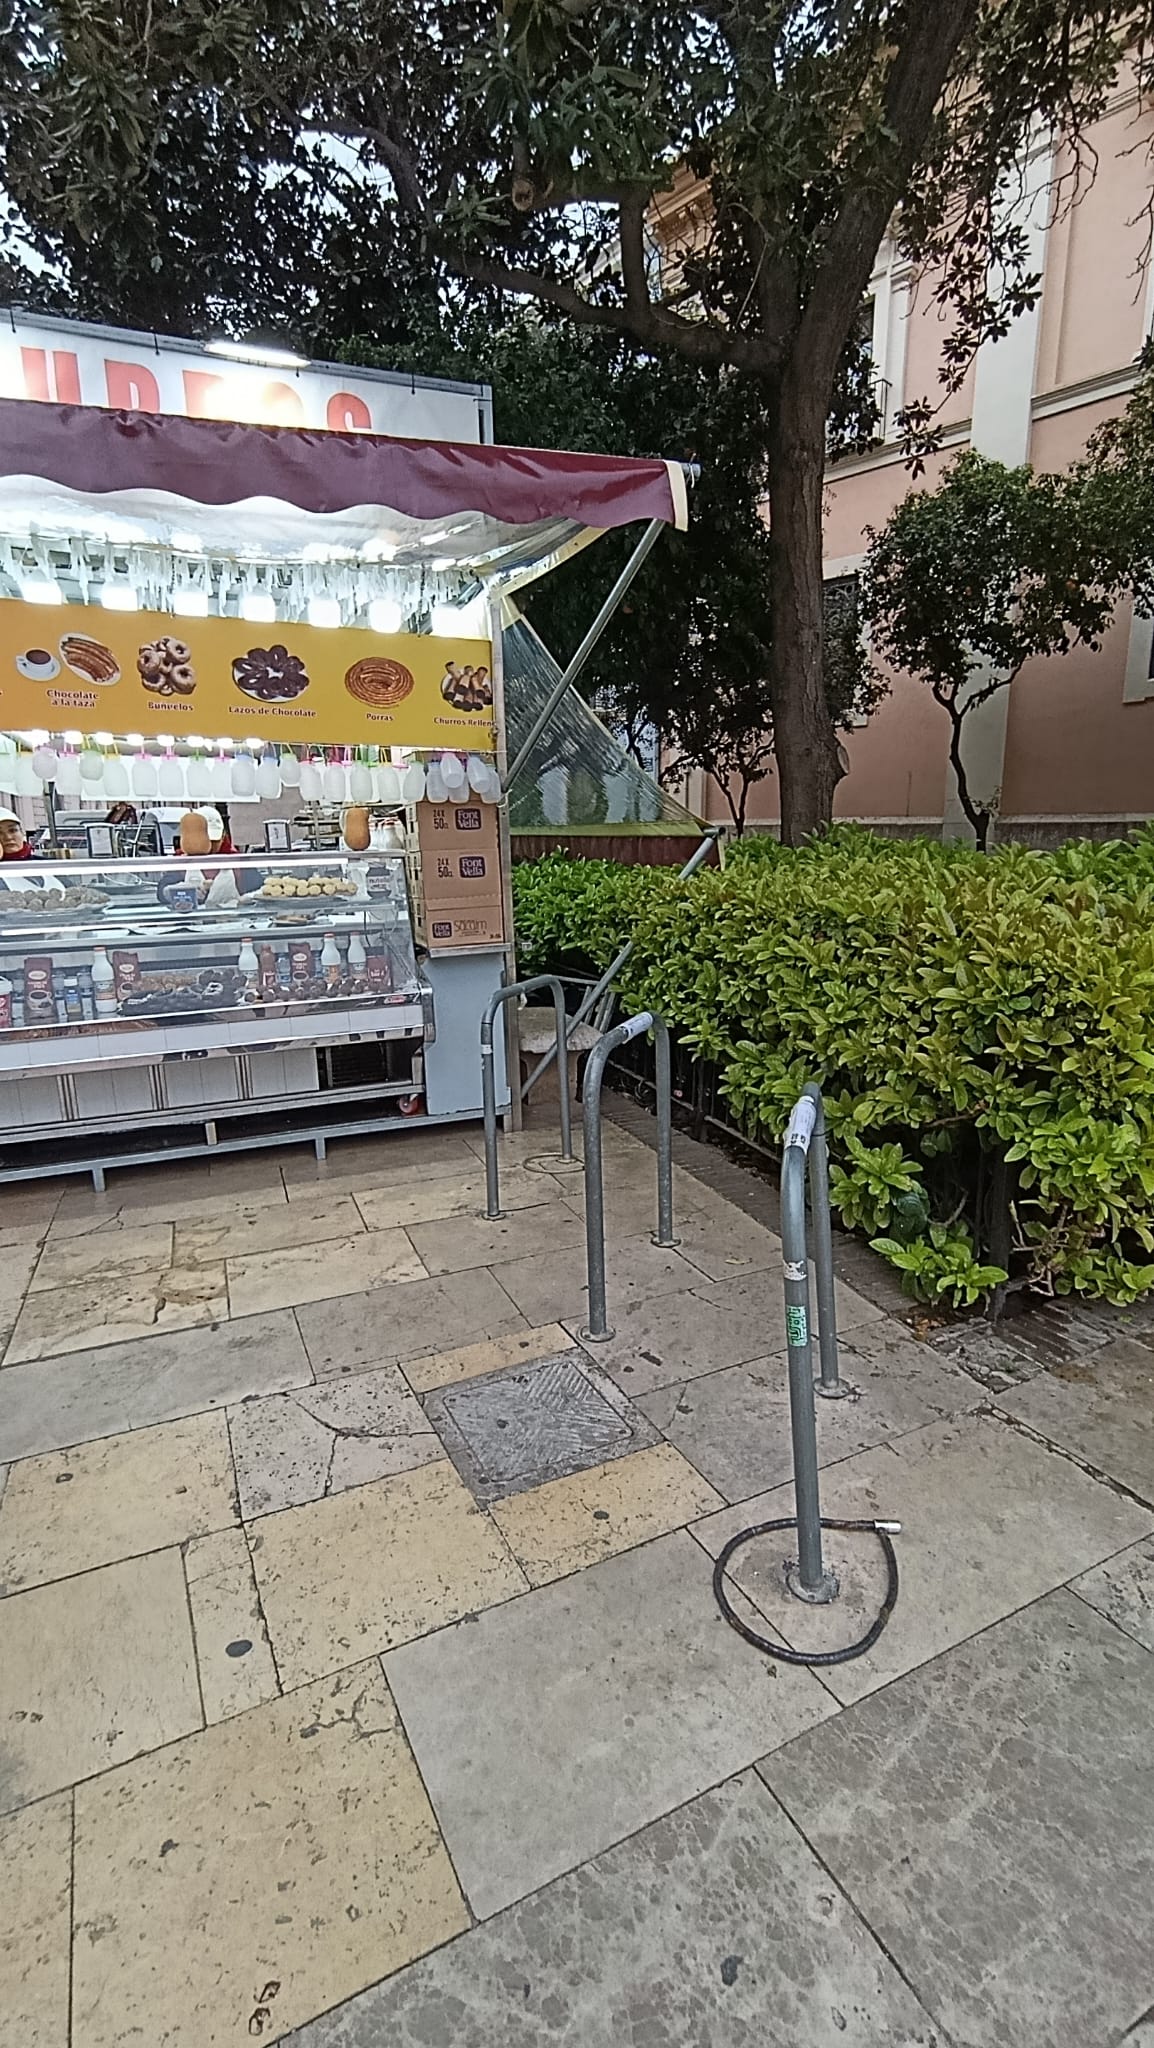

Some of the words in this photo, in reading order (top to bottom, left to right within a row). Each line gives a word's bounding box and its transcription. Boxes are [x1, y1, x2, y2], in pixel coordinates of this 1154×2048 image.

[46, 689, 99, 699] Chocolate
[73, 700, 95, 708] taza
[228, 706, 256, 714] Lazos
[258, 707, 270, 715] de
[271, 707, 317, 718] Chocolate
[366, 713, 394, 721] Porras
[433, 717, 466, 726] Churros
[457, 810, 479, 820] Font
[457, 819, 480, 829] Vella
[461, 858, 482, 868] Font
[461, 867, 484, 877] Vella
